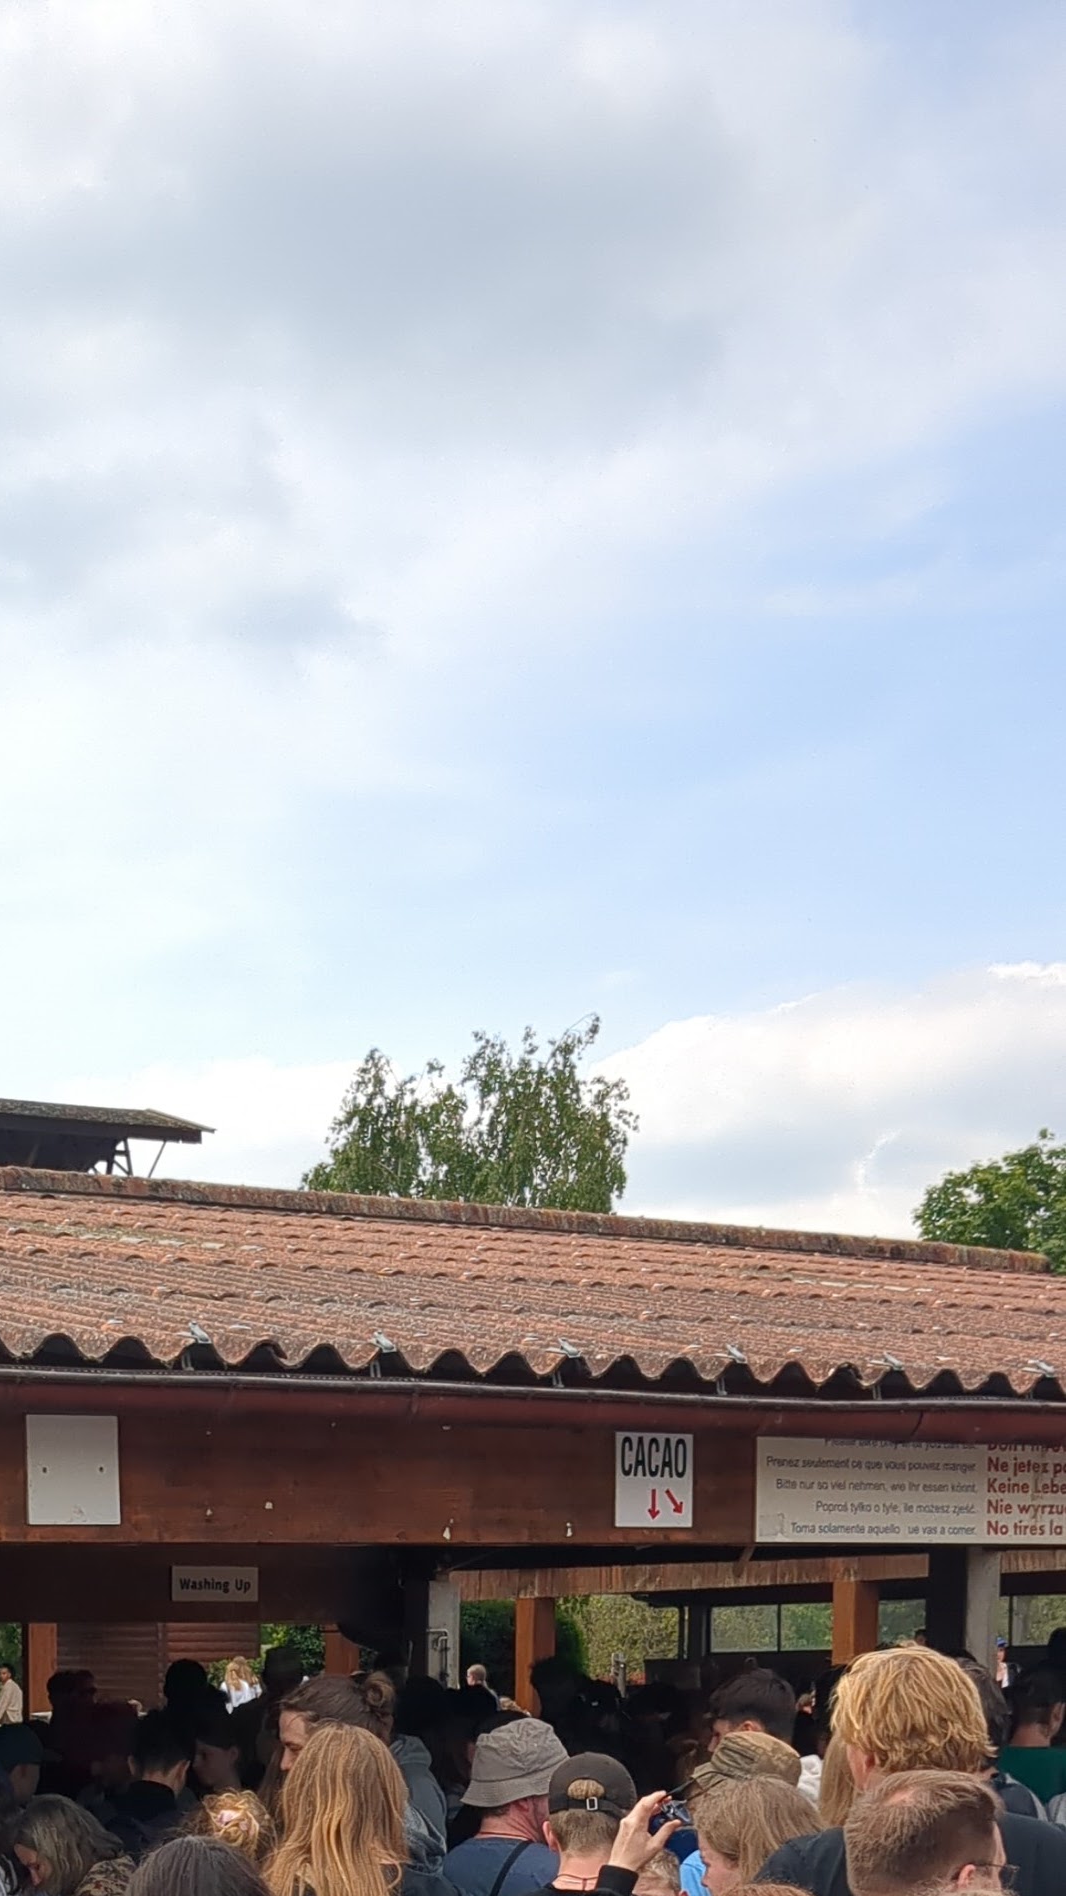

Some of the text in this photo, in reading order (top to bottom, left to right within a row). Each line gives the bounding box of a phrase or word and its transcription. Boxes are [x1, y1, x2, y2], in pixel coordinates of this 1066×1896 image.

[621, 1436, 687, 1478] CACAO
[987, 1456, 1009, 1473] Ne
[1013, 1456, 1049, 1477] jetez
[799, 1481, 814, 1490] nur
[817, 1481, 828, 1490] so
[922, 1483, 949, 1492] essen
[987, 1477, 1030, 1493] Keine
[874, 1504, 880, 1512] o
[987, 1498, 1066, 1519] Nie wyrzu
[791, 1522, 815, 1533] Toma
[818, 1522, 865, 1534] solamente
[922, 1526, 937, 1535] vas
[940, 1526, 946, 1535] a
[987, 1520, 1063, 1536] No tires la
[179, 1577, 251, 1594] Washing Up
